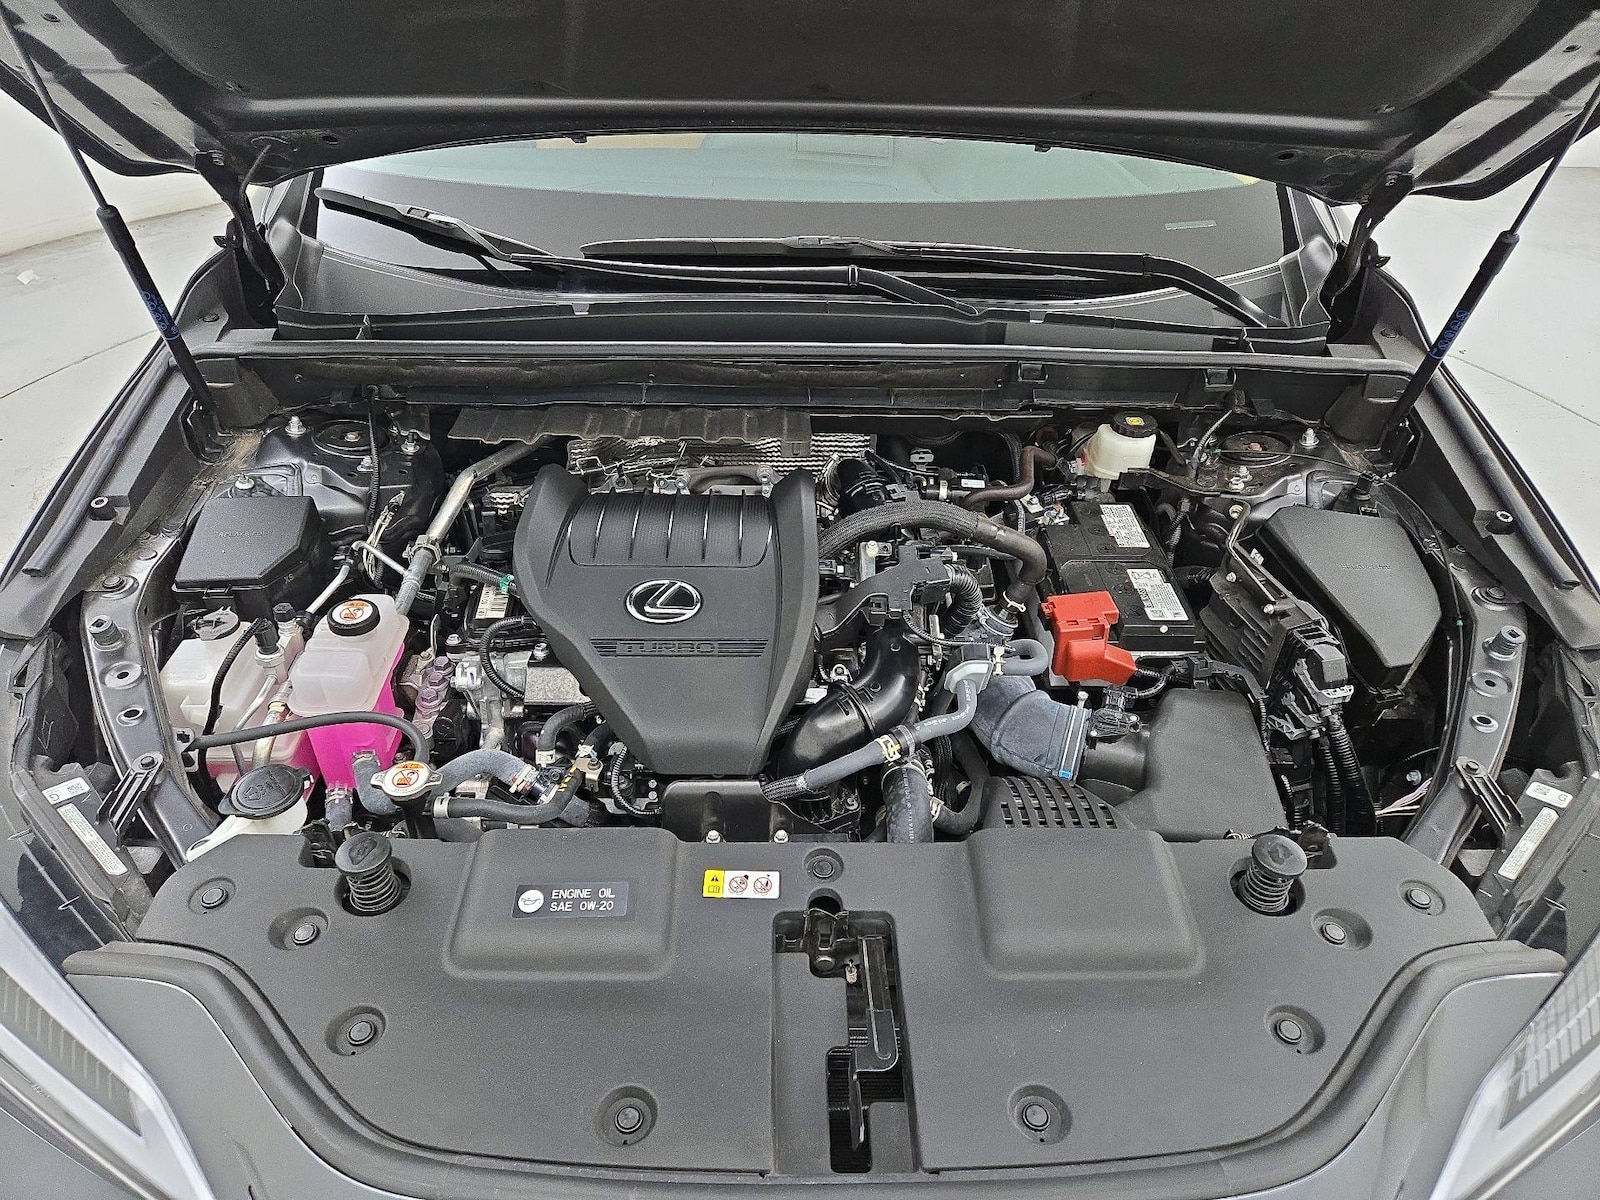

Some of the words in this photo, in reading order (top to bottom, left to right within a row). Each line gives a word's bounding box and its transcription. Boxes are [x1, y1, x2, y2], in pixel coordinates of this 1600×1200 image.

[619, 641, 716, 654] TURBO
[551, 889, 592, 899] ENGINE
[598, 888, 616, 898] OIL
[549, 902, 573, 912] SAE
[579, 901, 614, 911] 0W-20
